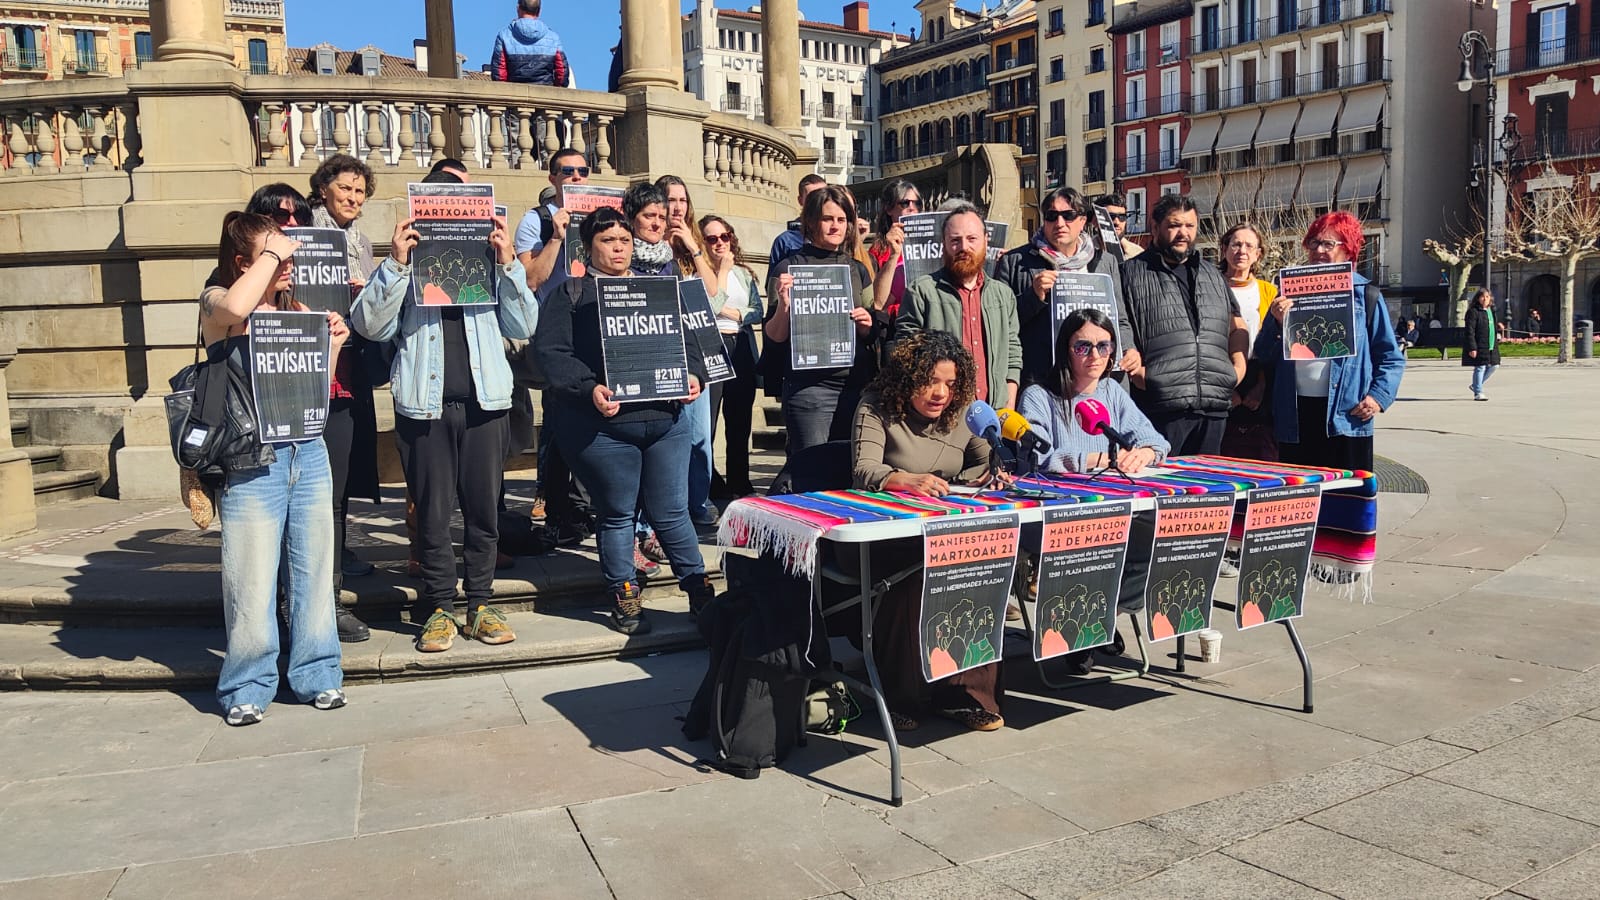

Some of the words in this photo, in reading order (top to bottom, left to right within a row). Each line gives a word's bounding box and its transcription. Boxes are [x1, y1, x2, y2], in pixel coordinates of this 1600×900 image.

[721, 56, 763, 73] HOTE
[816, 66, 866, 84] PERLA
[905, 240, 944, 260] REVÍSA
[1284, 274, 1349, 285] MANIFESTAZIOA
[1284, 284, 1336, 294] MARTXOAK
[794, 294, 852, 315] REVÍSATE.
[606, 312, 678, 336] REVÍSATE.
[682, 310, 714, 330] SATE.
[831, 342, 851, 352] #21M
[256, 347, 327, 373] REVÍSATE.
[655, 368, 682, 380] #21M
[304, 408, 325, 420] #21M
[1252, 501, 1316, 514] MANIFESTACIÓN
[1161, 510, 1229, 520] MANIFESTAZIOA
[1265, 516, 1276, 524] DE
[1281, 512, 1313, 522] MARZO
[1050, 520, 1126, 536] MANIFESTACIÓN
[1159, 521, 1214, 534] MARTXOAK
[1218, 521, 1227, 529] 21
[931, 532, 1014, 548] MANIFESTAZIOA
[1050, 539, 1061, 548] 21
[1066, 537, 1080, 546] DE
[1085, 531, 1123, 544] MARZO
[930, 546, 996, 562] MARTXOAK
[1002, 544, 1013, 553] 21
[947, 581, 982, 592] MERINDADES
